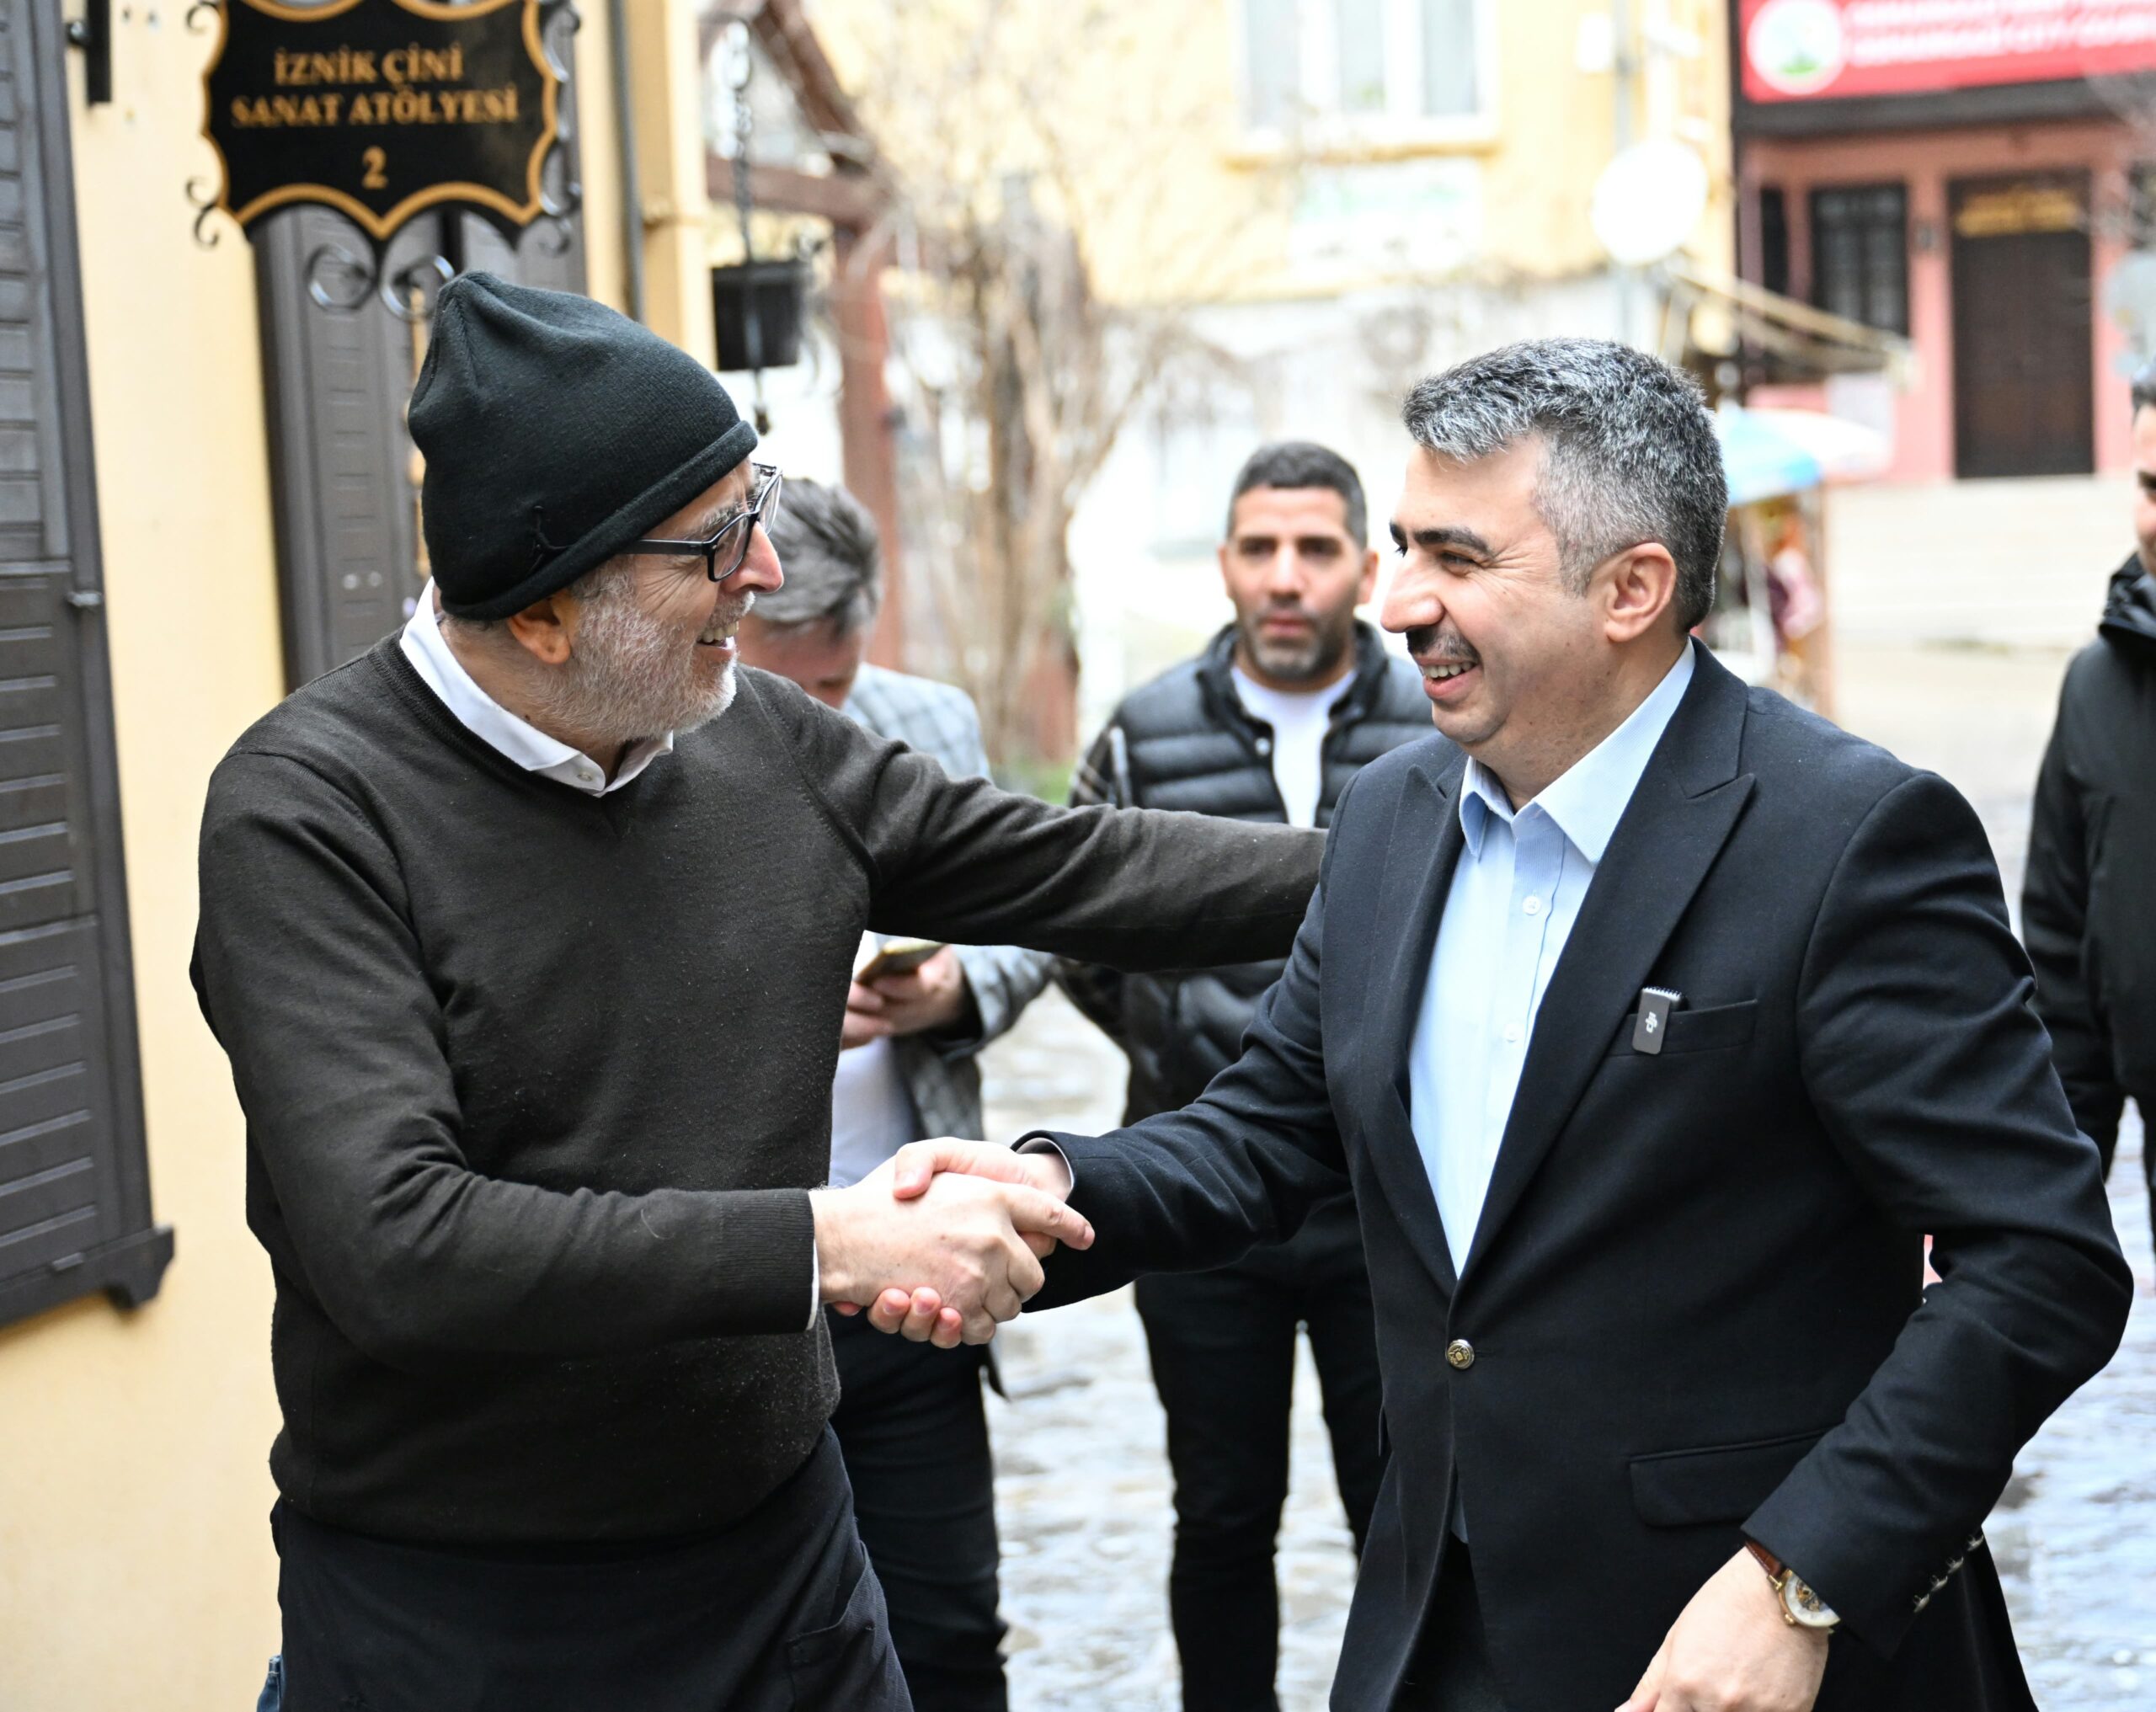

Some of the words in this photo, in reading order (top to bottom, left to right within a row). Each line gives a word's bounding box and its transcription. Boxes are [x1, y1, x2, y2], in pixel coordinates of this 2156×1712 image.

[275, 46, 377, 83] İZNİK
[382, 42, 464, 88] ÇİNİ
[231, 93, 339, 126] SANAT
[349, 84, 520, 125] ATÖLYESİ
[362, 146, 388, 189] 2
